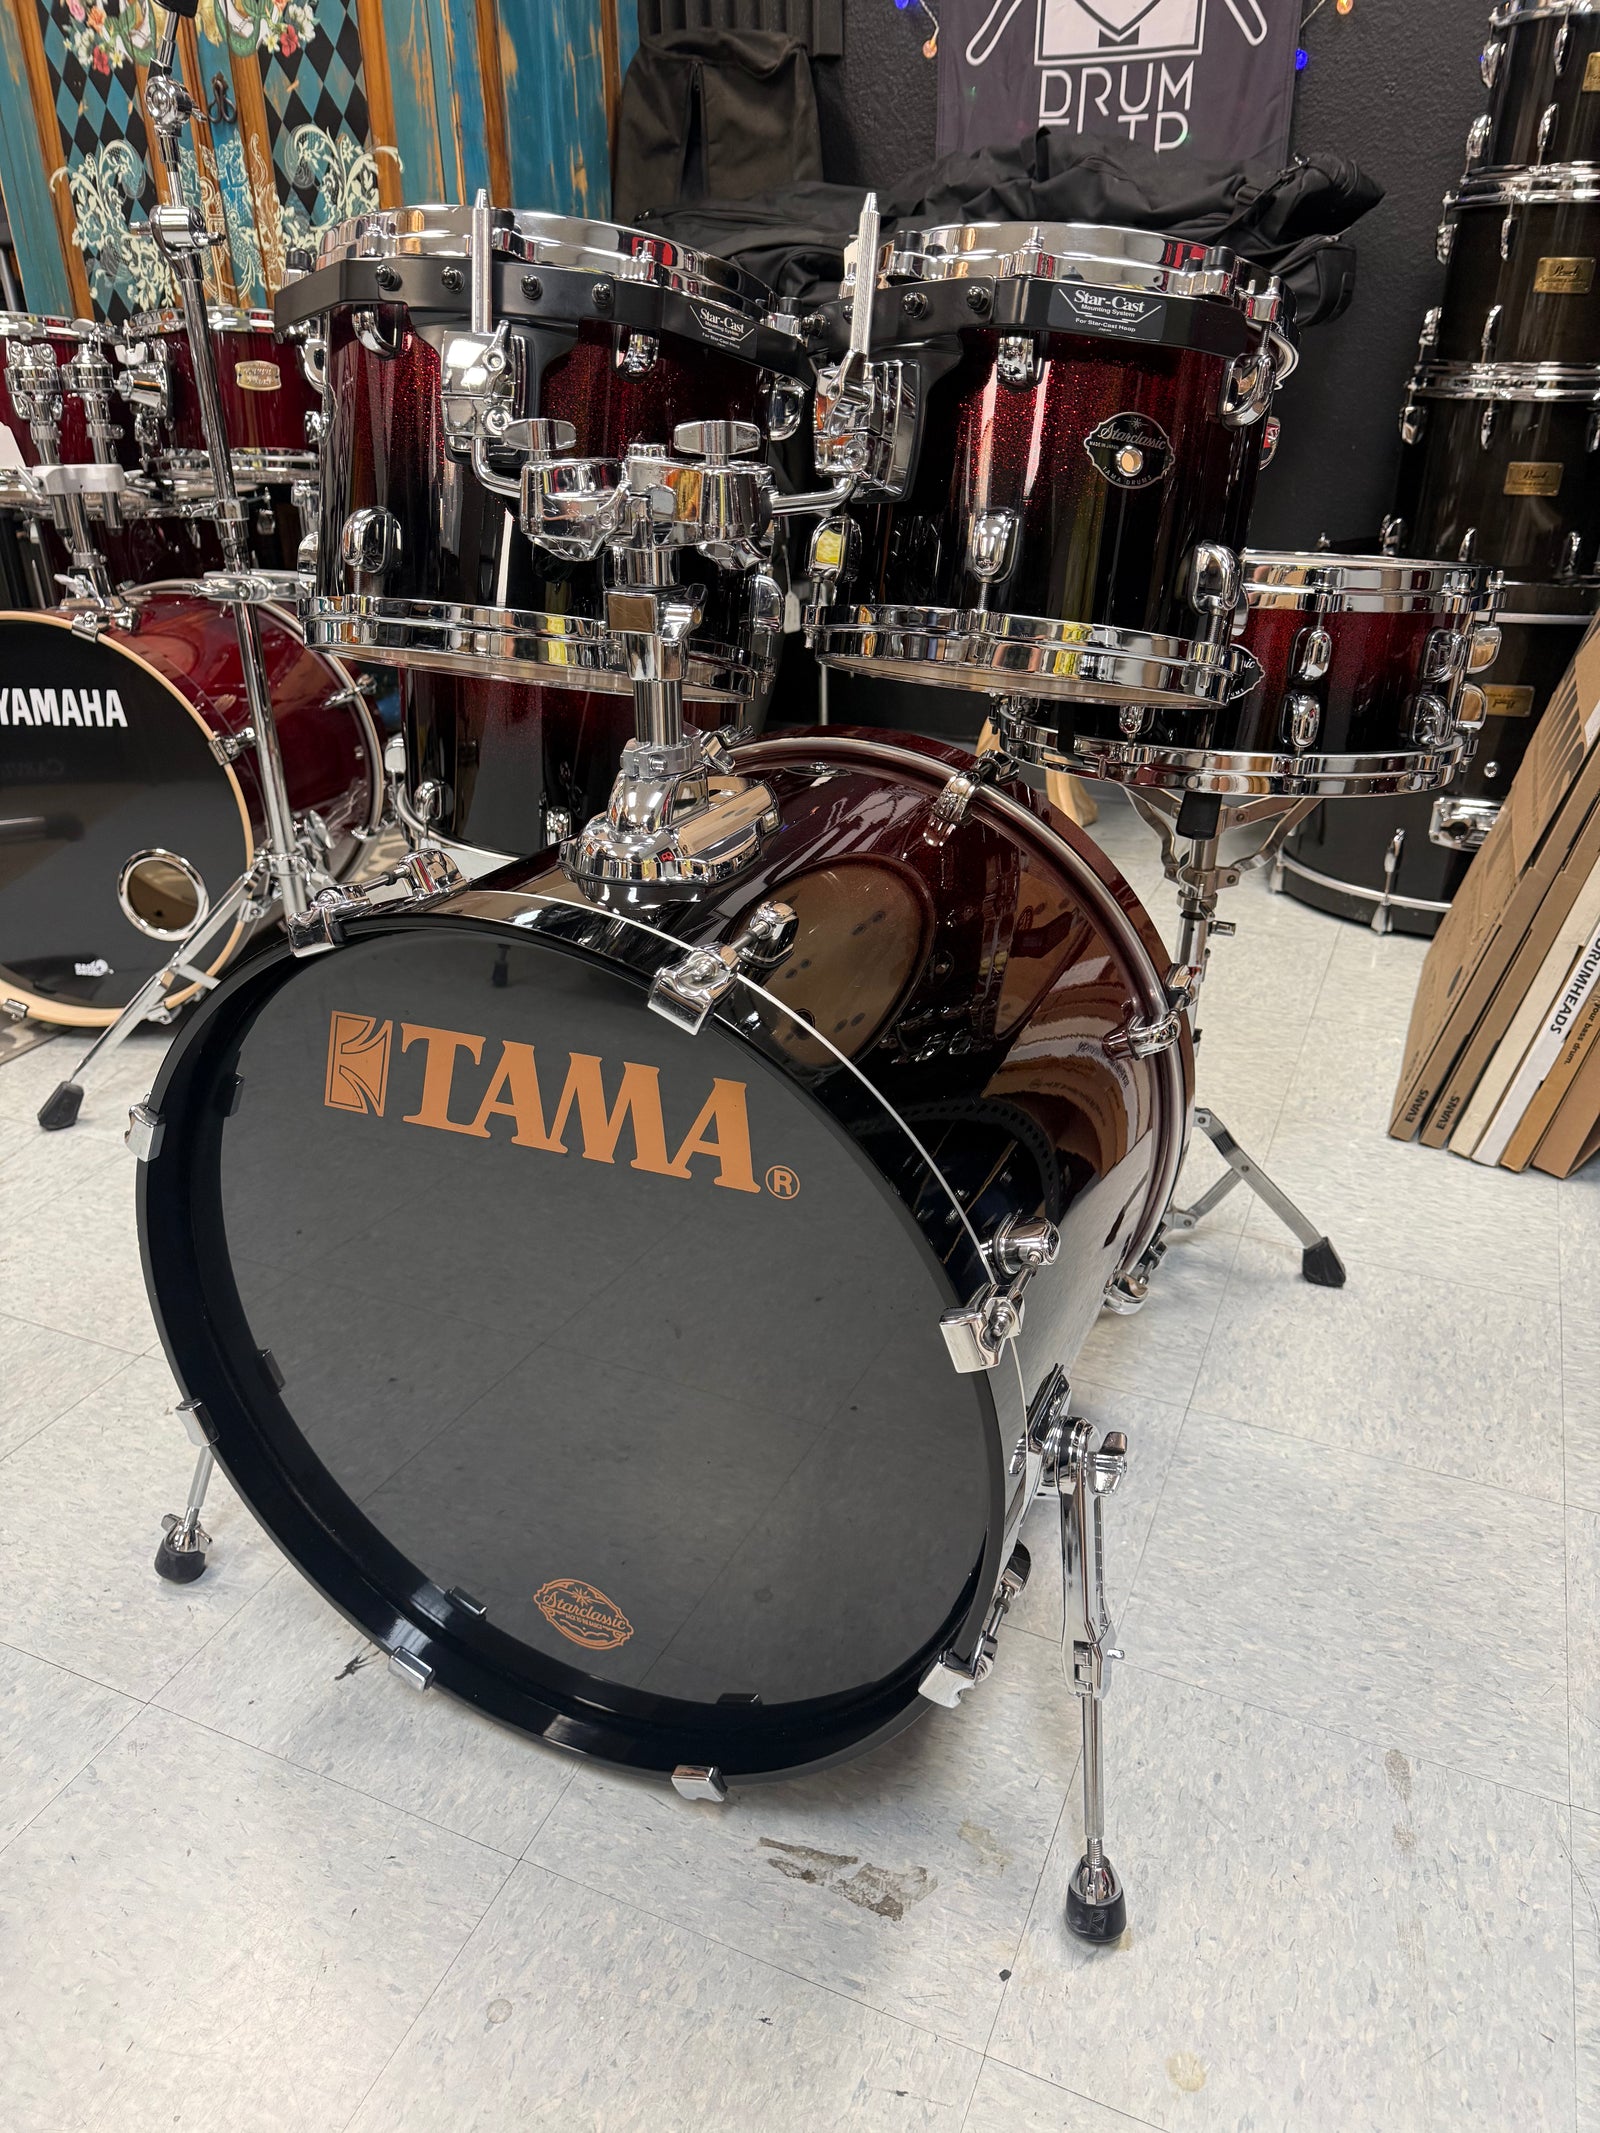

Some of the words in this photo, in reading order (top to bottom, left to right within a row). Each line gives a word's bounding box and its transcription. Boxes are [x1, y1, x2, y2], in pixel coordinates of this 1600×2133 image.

[1039, 60, 1194, 134] DRUM
[1074, 289, 1145, 313] Star-Cast
[700, 307, 744, 334] Star-Cast
[1097, 421, 1167, 450] Starclassic
[1102, 466, 1121, 482] TAMA
[1125, 474, 1152, 485] DRUMS
[0, 687, 129, 728] YAMAHA
[401, 1022, 762, 1194] TAMA
[1405, 1088, 1430, 1124] EVANS
[1436, 1095, 1461, 1130] EVANS
[541, 1590, 627, 1631] Starclassic
